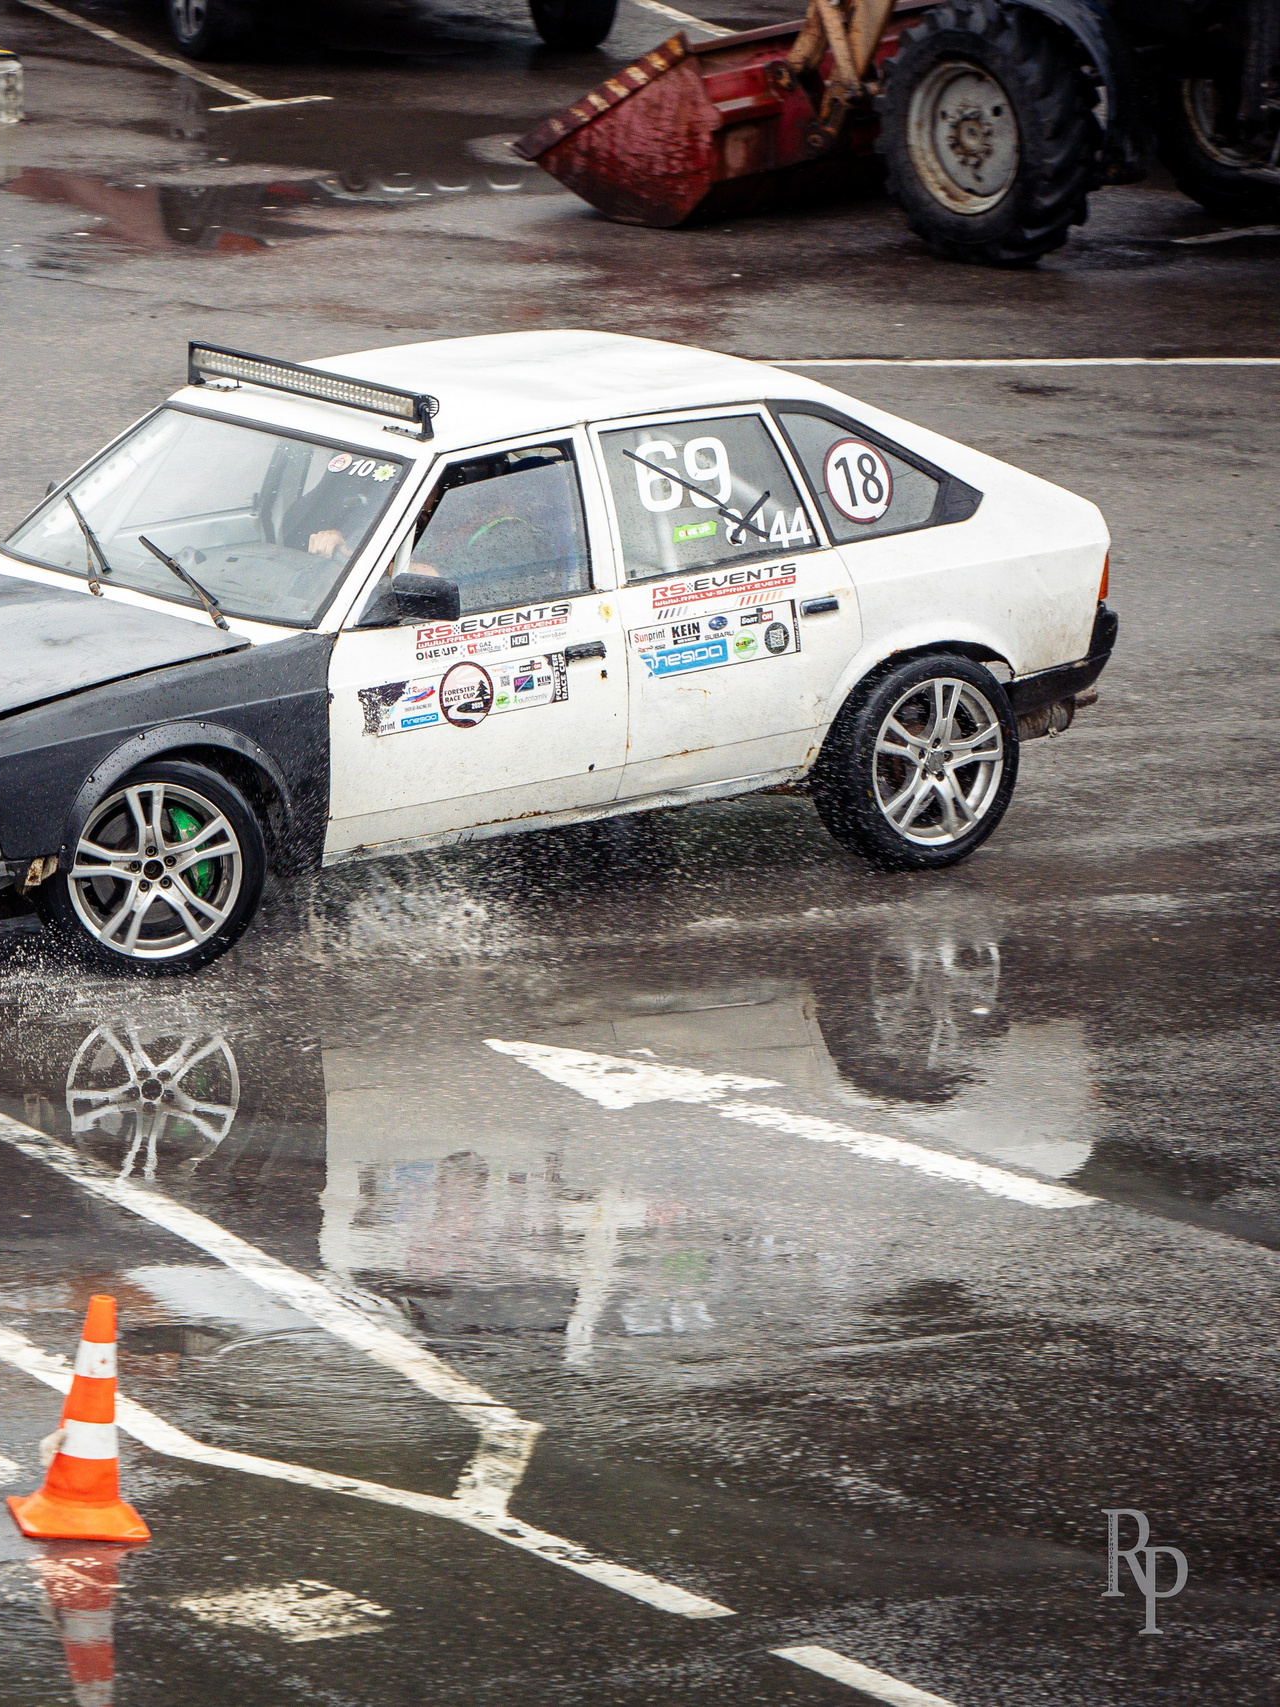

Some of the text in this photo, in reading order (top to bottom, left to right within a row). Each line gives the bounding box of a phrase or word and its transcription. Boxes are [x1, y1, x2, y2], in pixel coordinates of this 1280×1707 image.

[348, 459, 377, 477] 10
[634, 436, 732, 512] 69
[834, 452, 884, 507] 18
[653, 562, 797, 599] RS EVENTS
[416, 603, 570, 642] RS EVENTS
[671, 621, 701, 638] KEIN
[633, 628, 666, 643] Sunprint
[704, 630, 734, 641] SUBARU
[551, 653, 562, 701] FORESTER
[560, 672, 568, 700] RACE
[443, 685, 475, 697] FORESTER
[444, 691, 476, 703] RACE CUP
